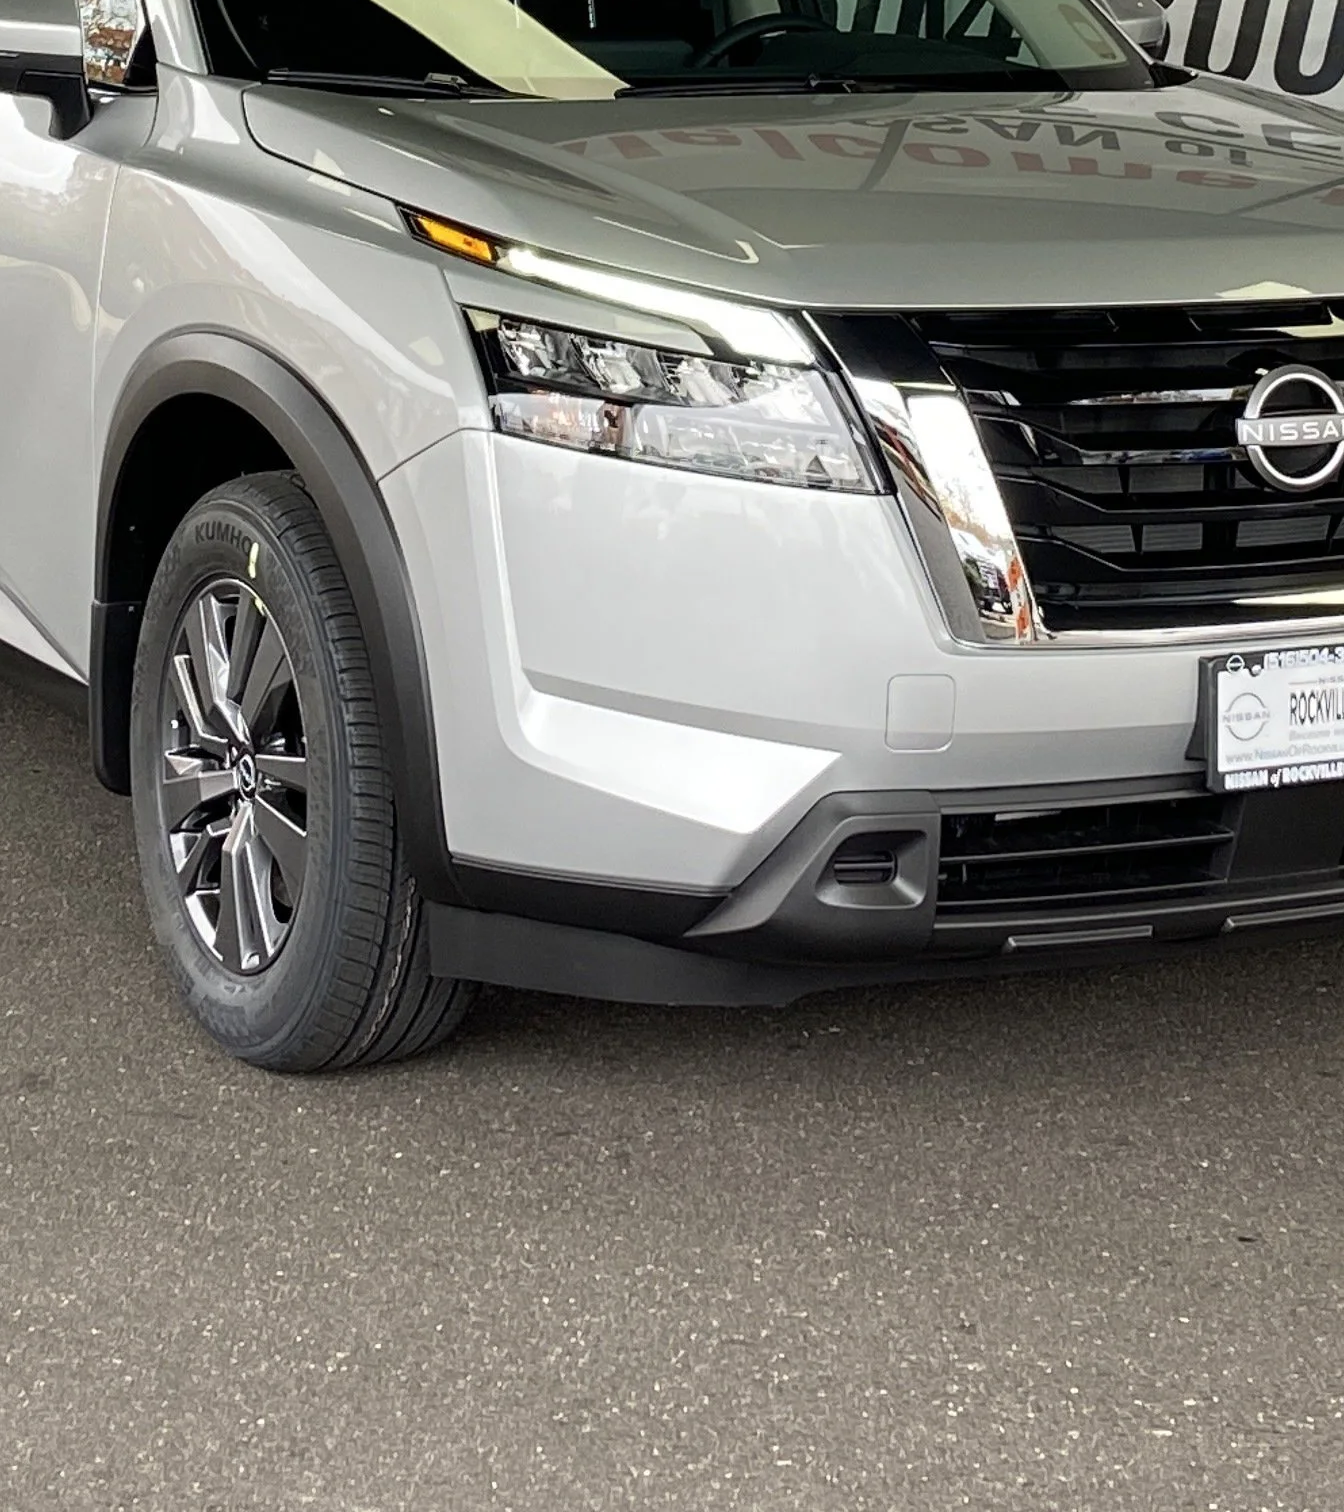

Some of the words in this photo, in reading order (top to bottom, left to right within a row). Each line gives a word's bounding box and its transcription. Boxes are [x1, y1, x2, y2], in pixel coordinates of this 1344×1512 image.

[195, 520, 253, 555] KUMHO
[1222, 710, 1271, 723] NISSAN
[1224, 770, 1268, 790] NISSAN
